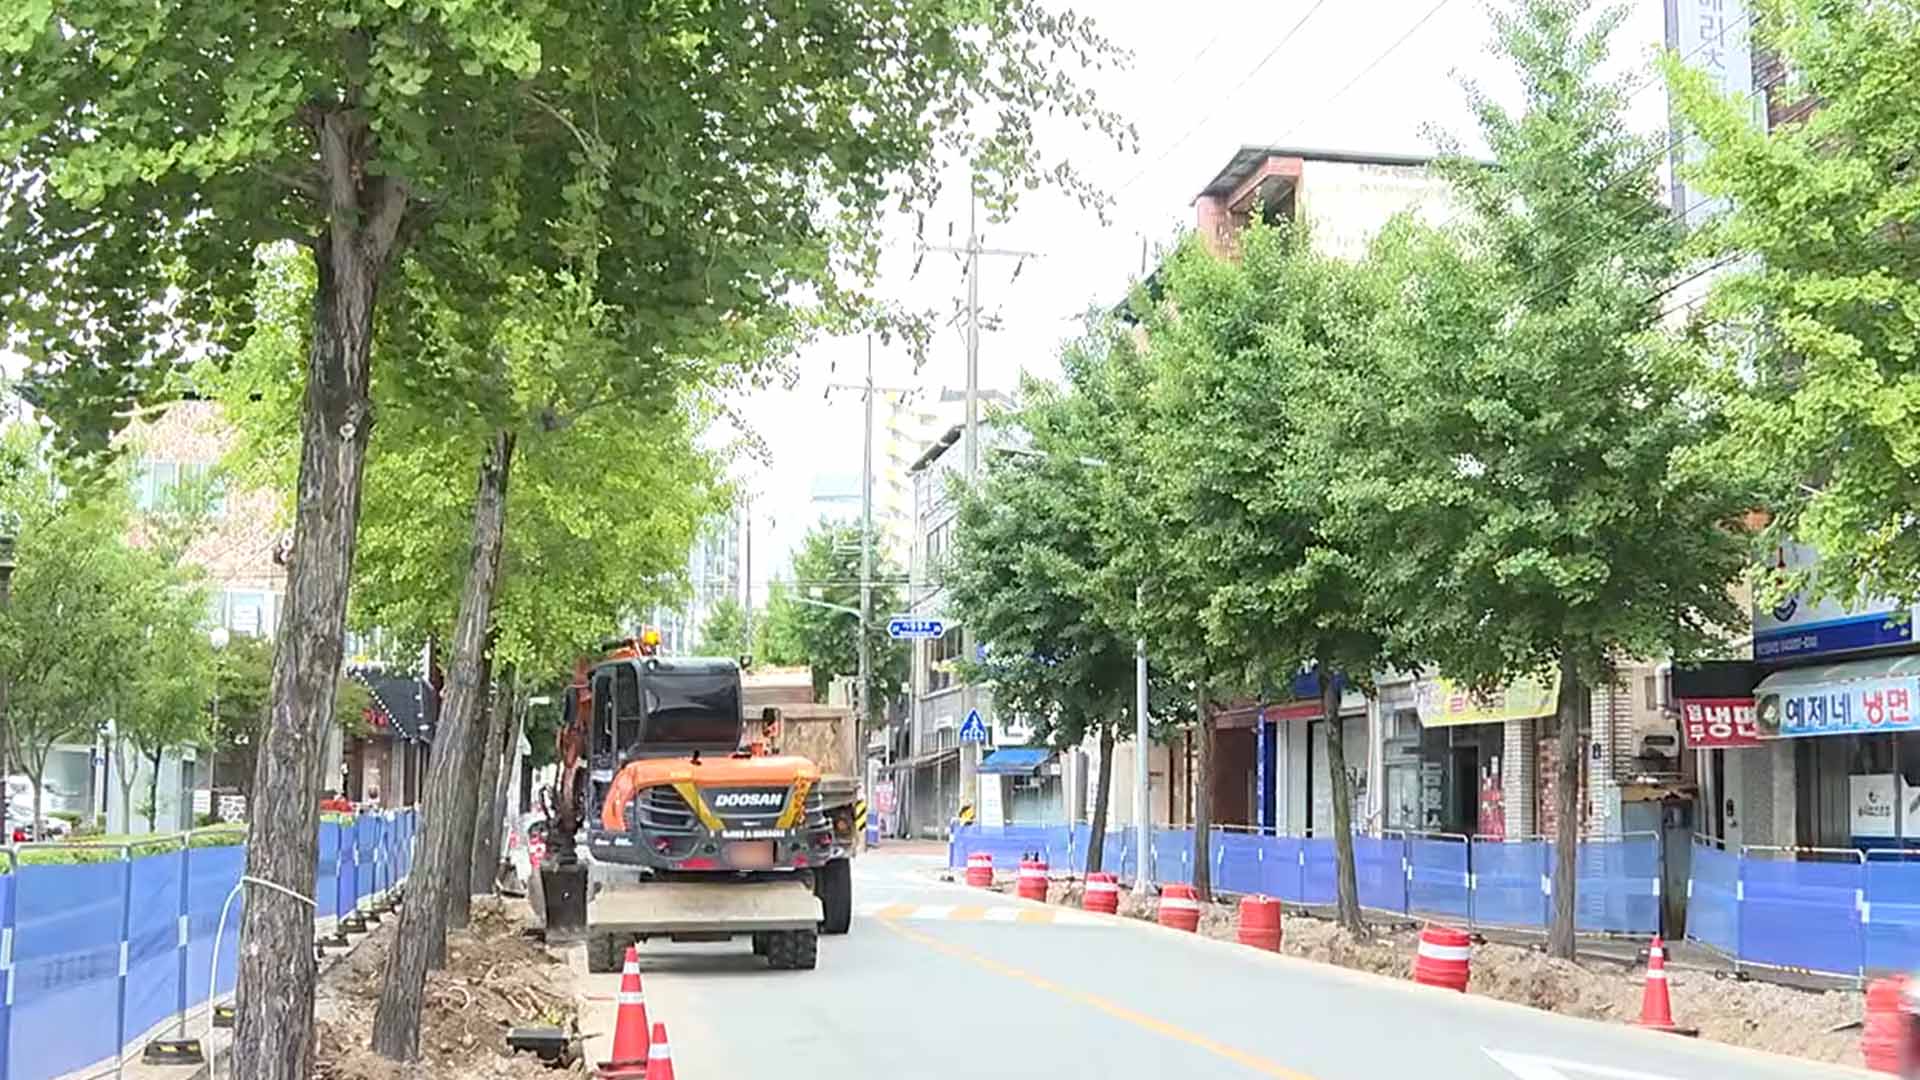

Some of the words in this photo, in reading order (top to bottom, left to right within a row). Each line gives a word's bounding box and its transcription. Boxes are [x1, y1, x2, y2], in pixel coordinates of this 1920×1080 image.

[1704, 705, 1759, 738] 냉면
[1786, 693, 1851, 728] 예제네
[1863, 687, 1909, 724] 냉면
[715, 793, 782, 807] DOOSAN
